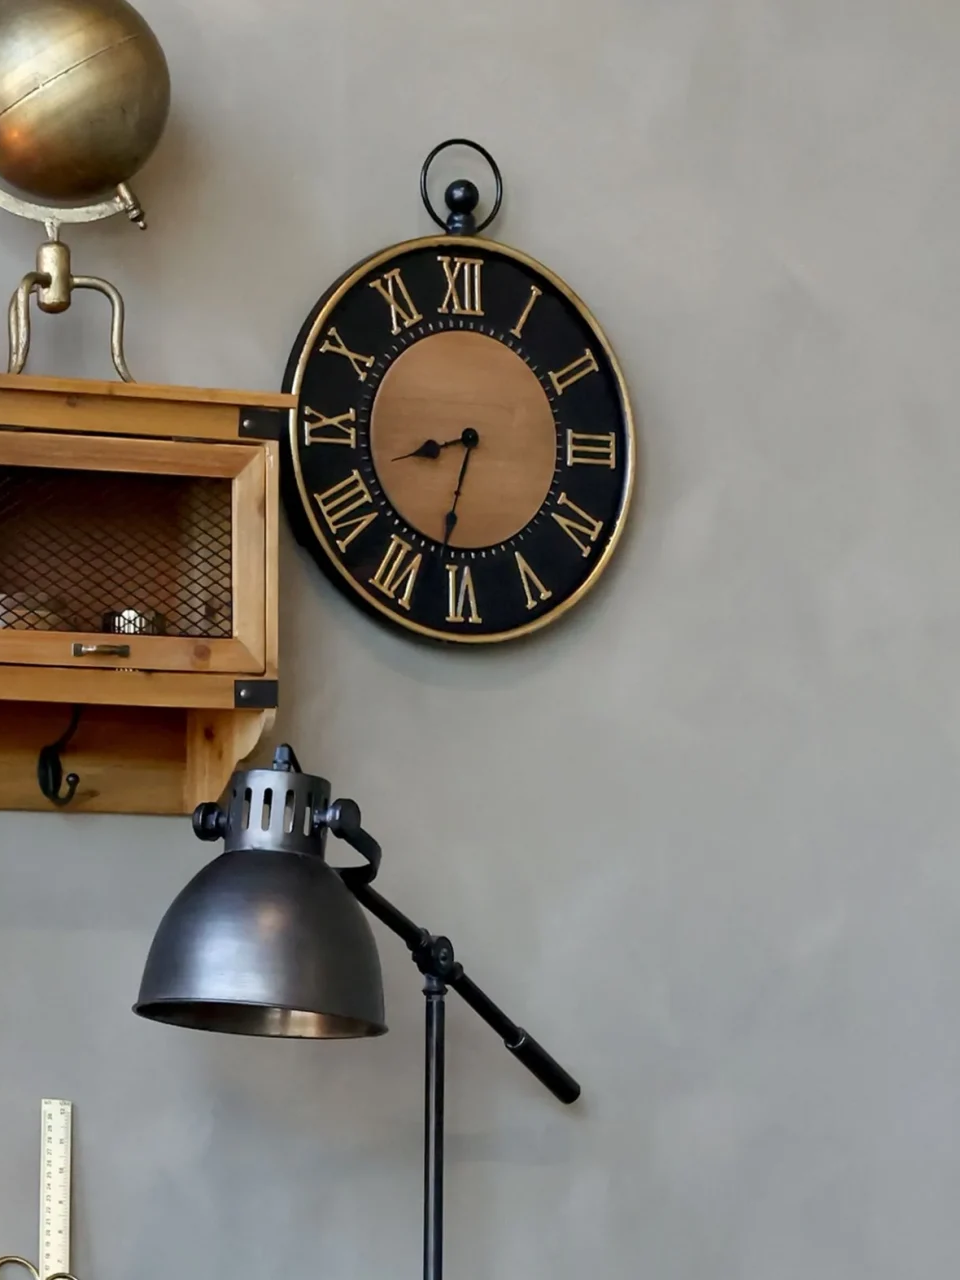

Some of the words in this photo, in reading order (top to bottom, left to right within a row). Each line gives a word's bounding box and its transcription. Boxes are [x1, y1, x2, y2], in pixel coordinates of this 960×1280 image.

[369, 268, 423, 335] XI
[437, 256, 484, 316] XII
[510, 285, 542, 338] I
[319, 327, 375, 381] X
[548, 348, 599, 395] II
[304, 406, 356, 449] IX
[567, 429, 616, 468] III
[314, 470, 378, 553] VIII
[552, 493, 604, 557] IV
[369, 534, 422, 610] VII
[446, 565, 482, 623] VI
[515, 552, 553, 609] V
